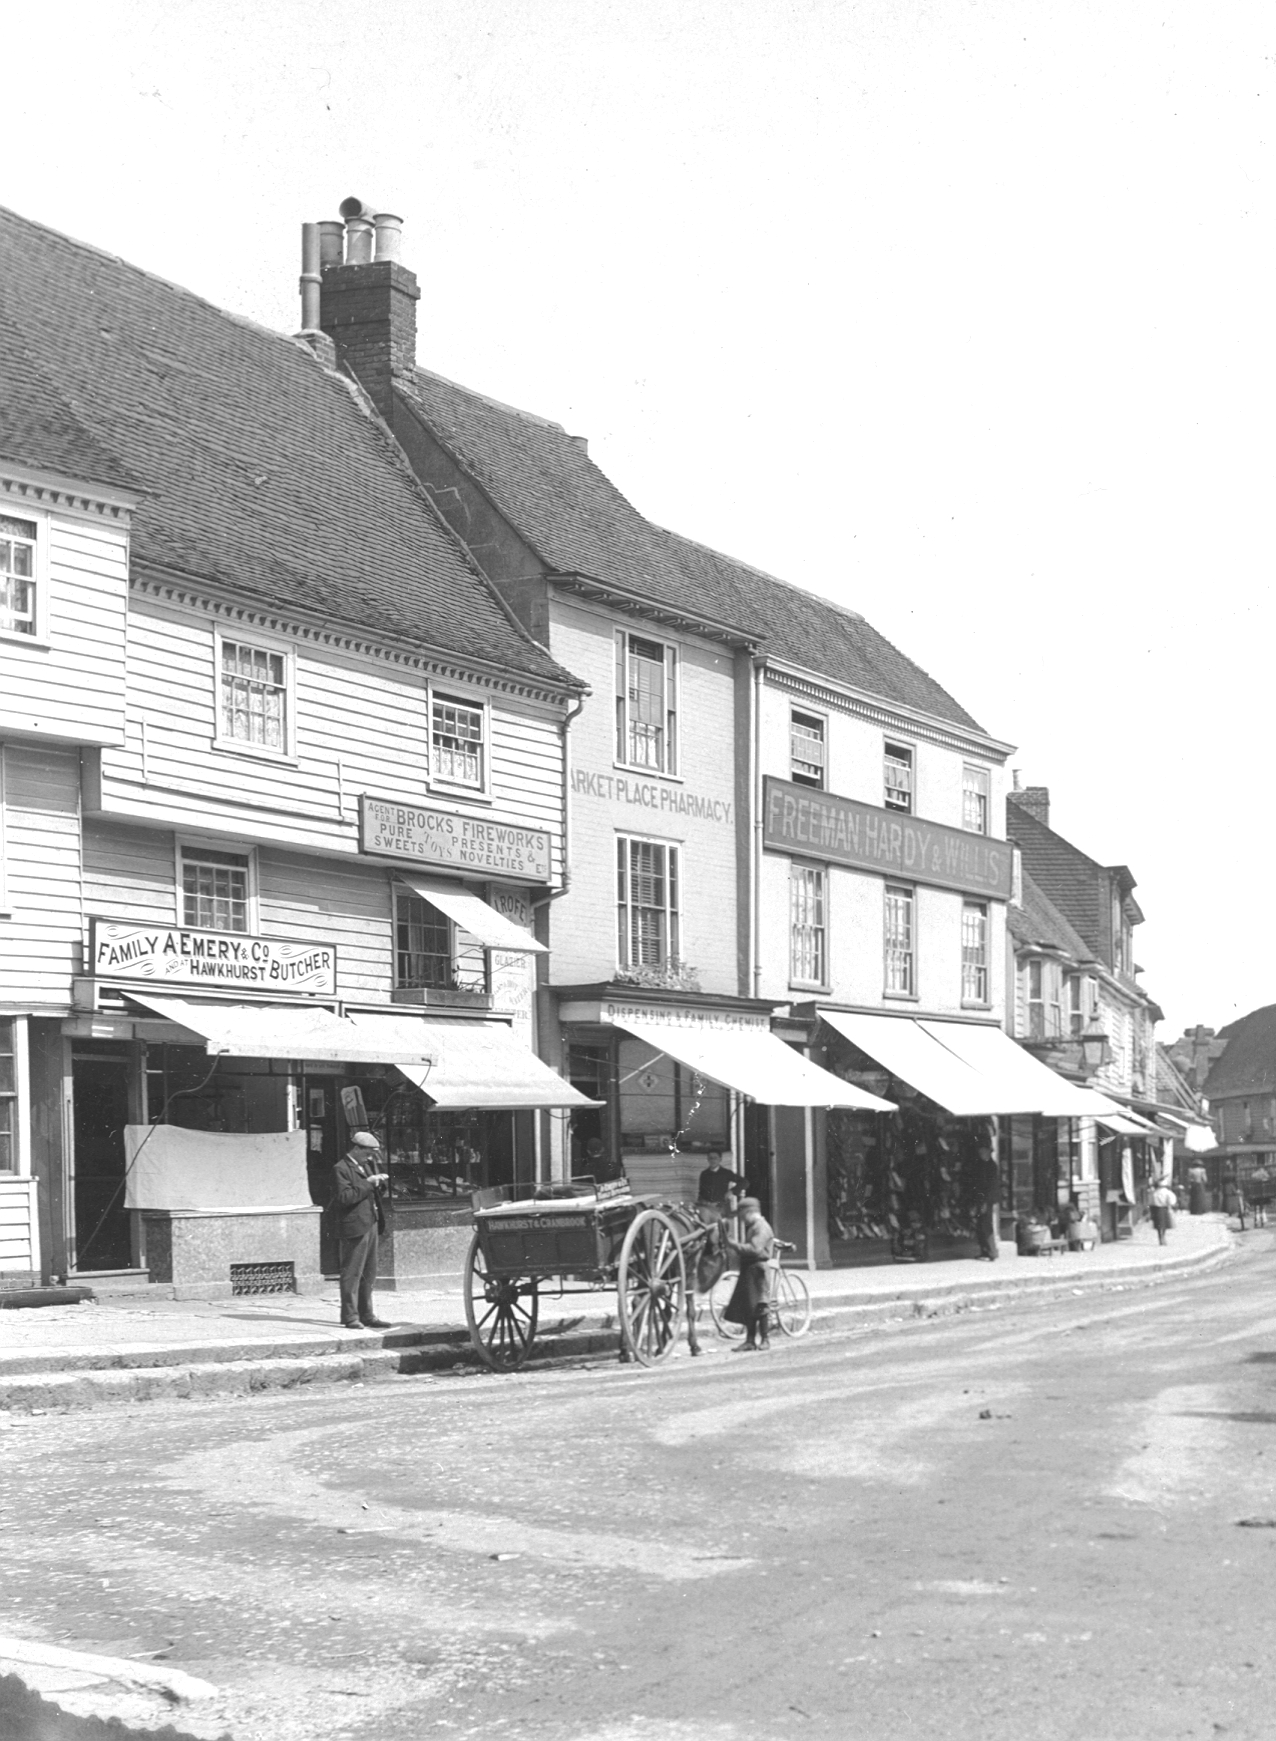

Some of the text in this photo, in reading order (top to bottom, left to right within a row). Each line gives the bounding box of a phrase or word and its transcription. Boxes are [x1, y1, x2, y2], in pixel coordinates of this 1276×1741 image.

[617, 778, 658, 809] PLACE
[368, 802, 544, 851] AGENT BROCKS FIREWORKS
[375, 813, 391, 822] FOR
[374, 835, 424, 854] SWEETS
[460, 850, 524, 871] NOVELTIES
[380, 823, 536, 863] PURE TOYS PRESENTS &
[866, 815, 931, 869] HARDY
[931, 845, 943, 872] &
[944, 835, 1000, 886] WILLIS
[97, 936, 159, 965] FAMILY
[179, 933, 242, 960] EMERY
[240, 948, 250, 961] &
[495, 954, 527, 969] GLAZIER
[165, 959, 266, 981] AND AT HAWKHURST
[269, 951, 331, 981] BUTCHER
[608, 1004, 671, 1021] DISPENSING
[685, 1010, 720, 1025] FAMILY
[725, 1014, 766, 1027] CHEMIST
